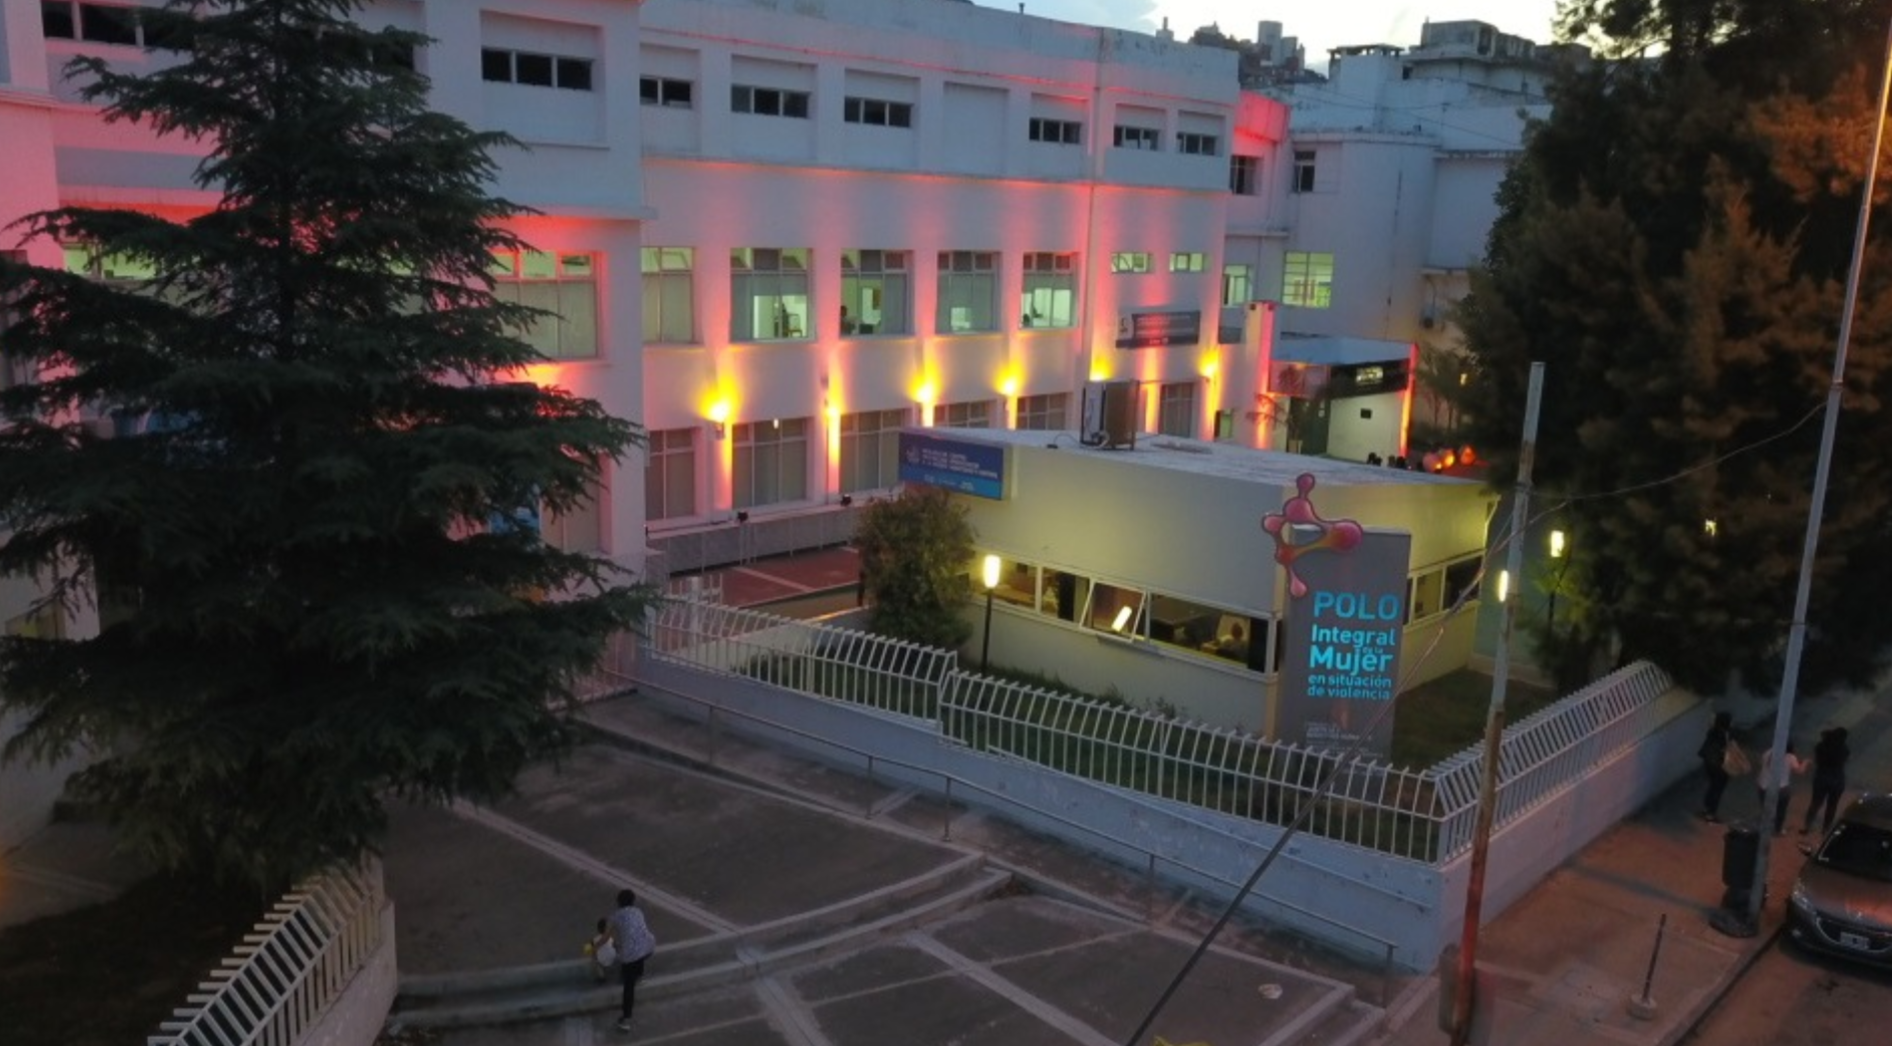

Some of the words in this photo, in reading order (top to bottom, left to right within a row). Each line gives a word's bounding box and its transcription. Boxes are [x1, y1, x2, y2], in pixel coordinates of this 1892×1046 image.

[1313, 590, 1399, 620] POLO
[1311, 623, 1395, 648] Integral
[1309, 644, 1394, 676] Mujer
[1307, 674, 1326, 686] en
[1328, 674, 1392, 688] situación
[1307, 685, 1325, 697] de
[1327, 686, 1391, 700] violencia
